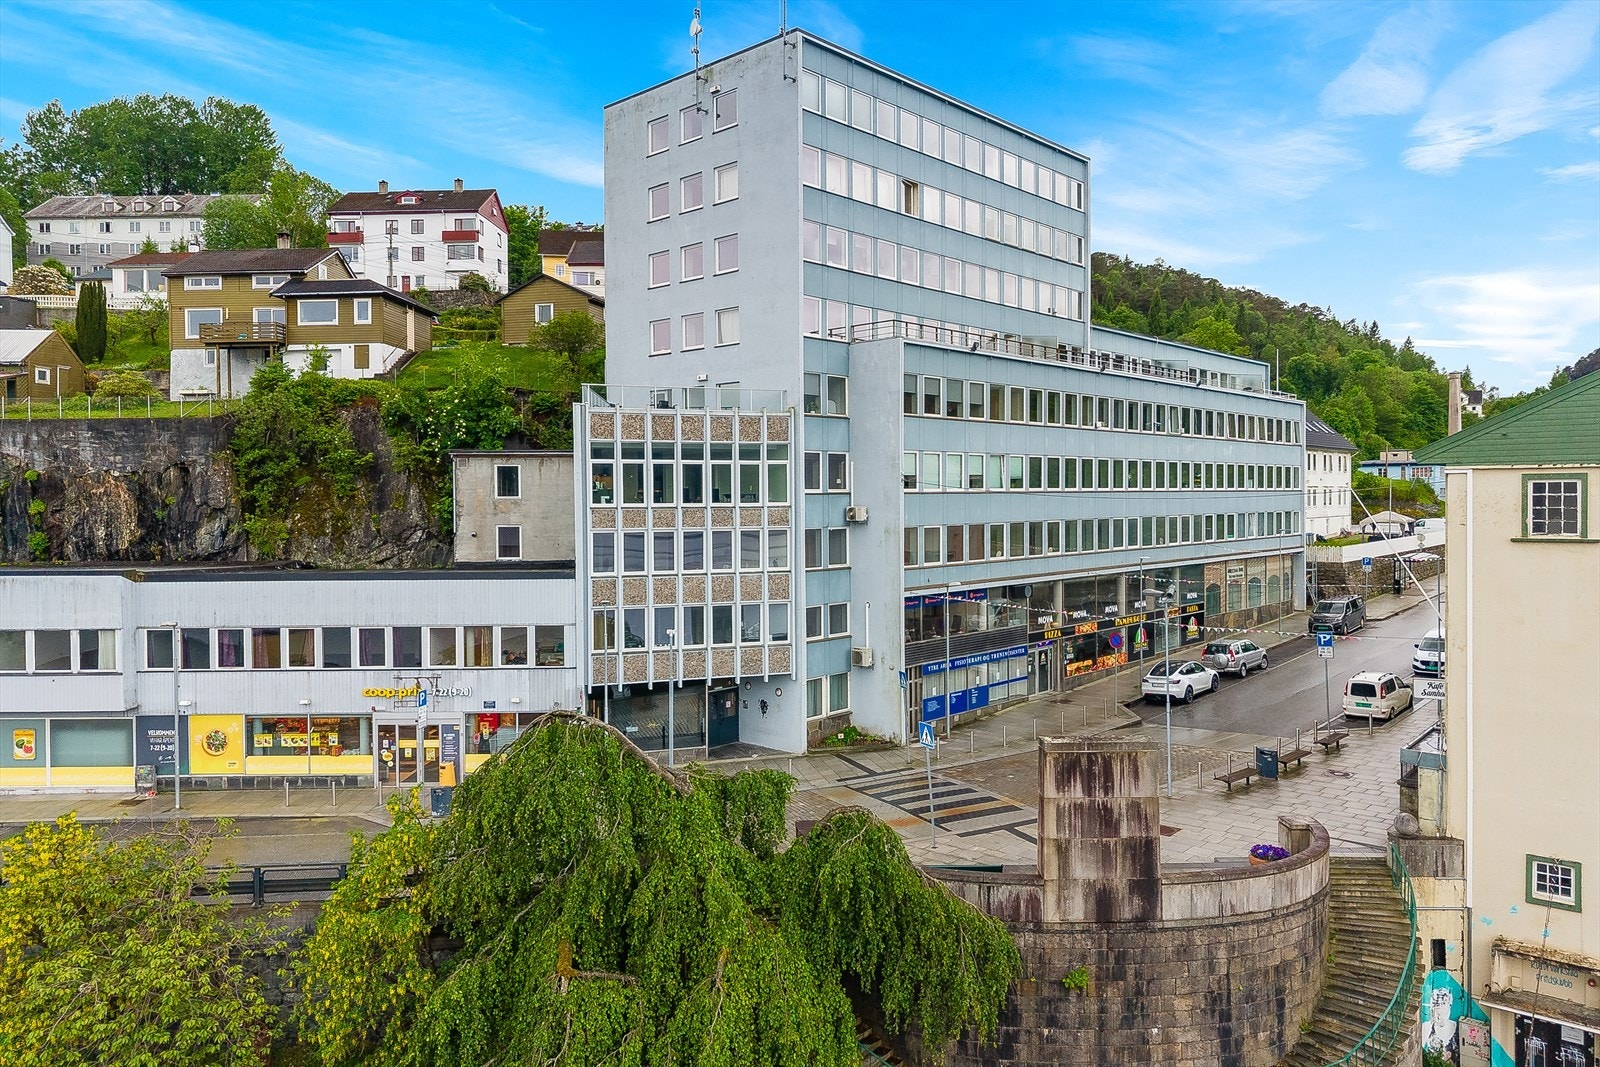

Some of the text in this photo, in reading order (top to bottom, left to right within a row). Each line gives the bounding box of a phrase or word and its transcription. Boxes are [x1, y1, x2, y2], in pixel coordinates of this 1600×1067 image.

[1044, 630, 1062, 639] PIZZA
[1320, 634, 1331, 645] P
[362, 687, 396, 699] coop
[420, 692, 425, 705] P
